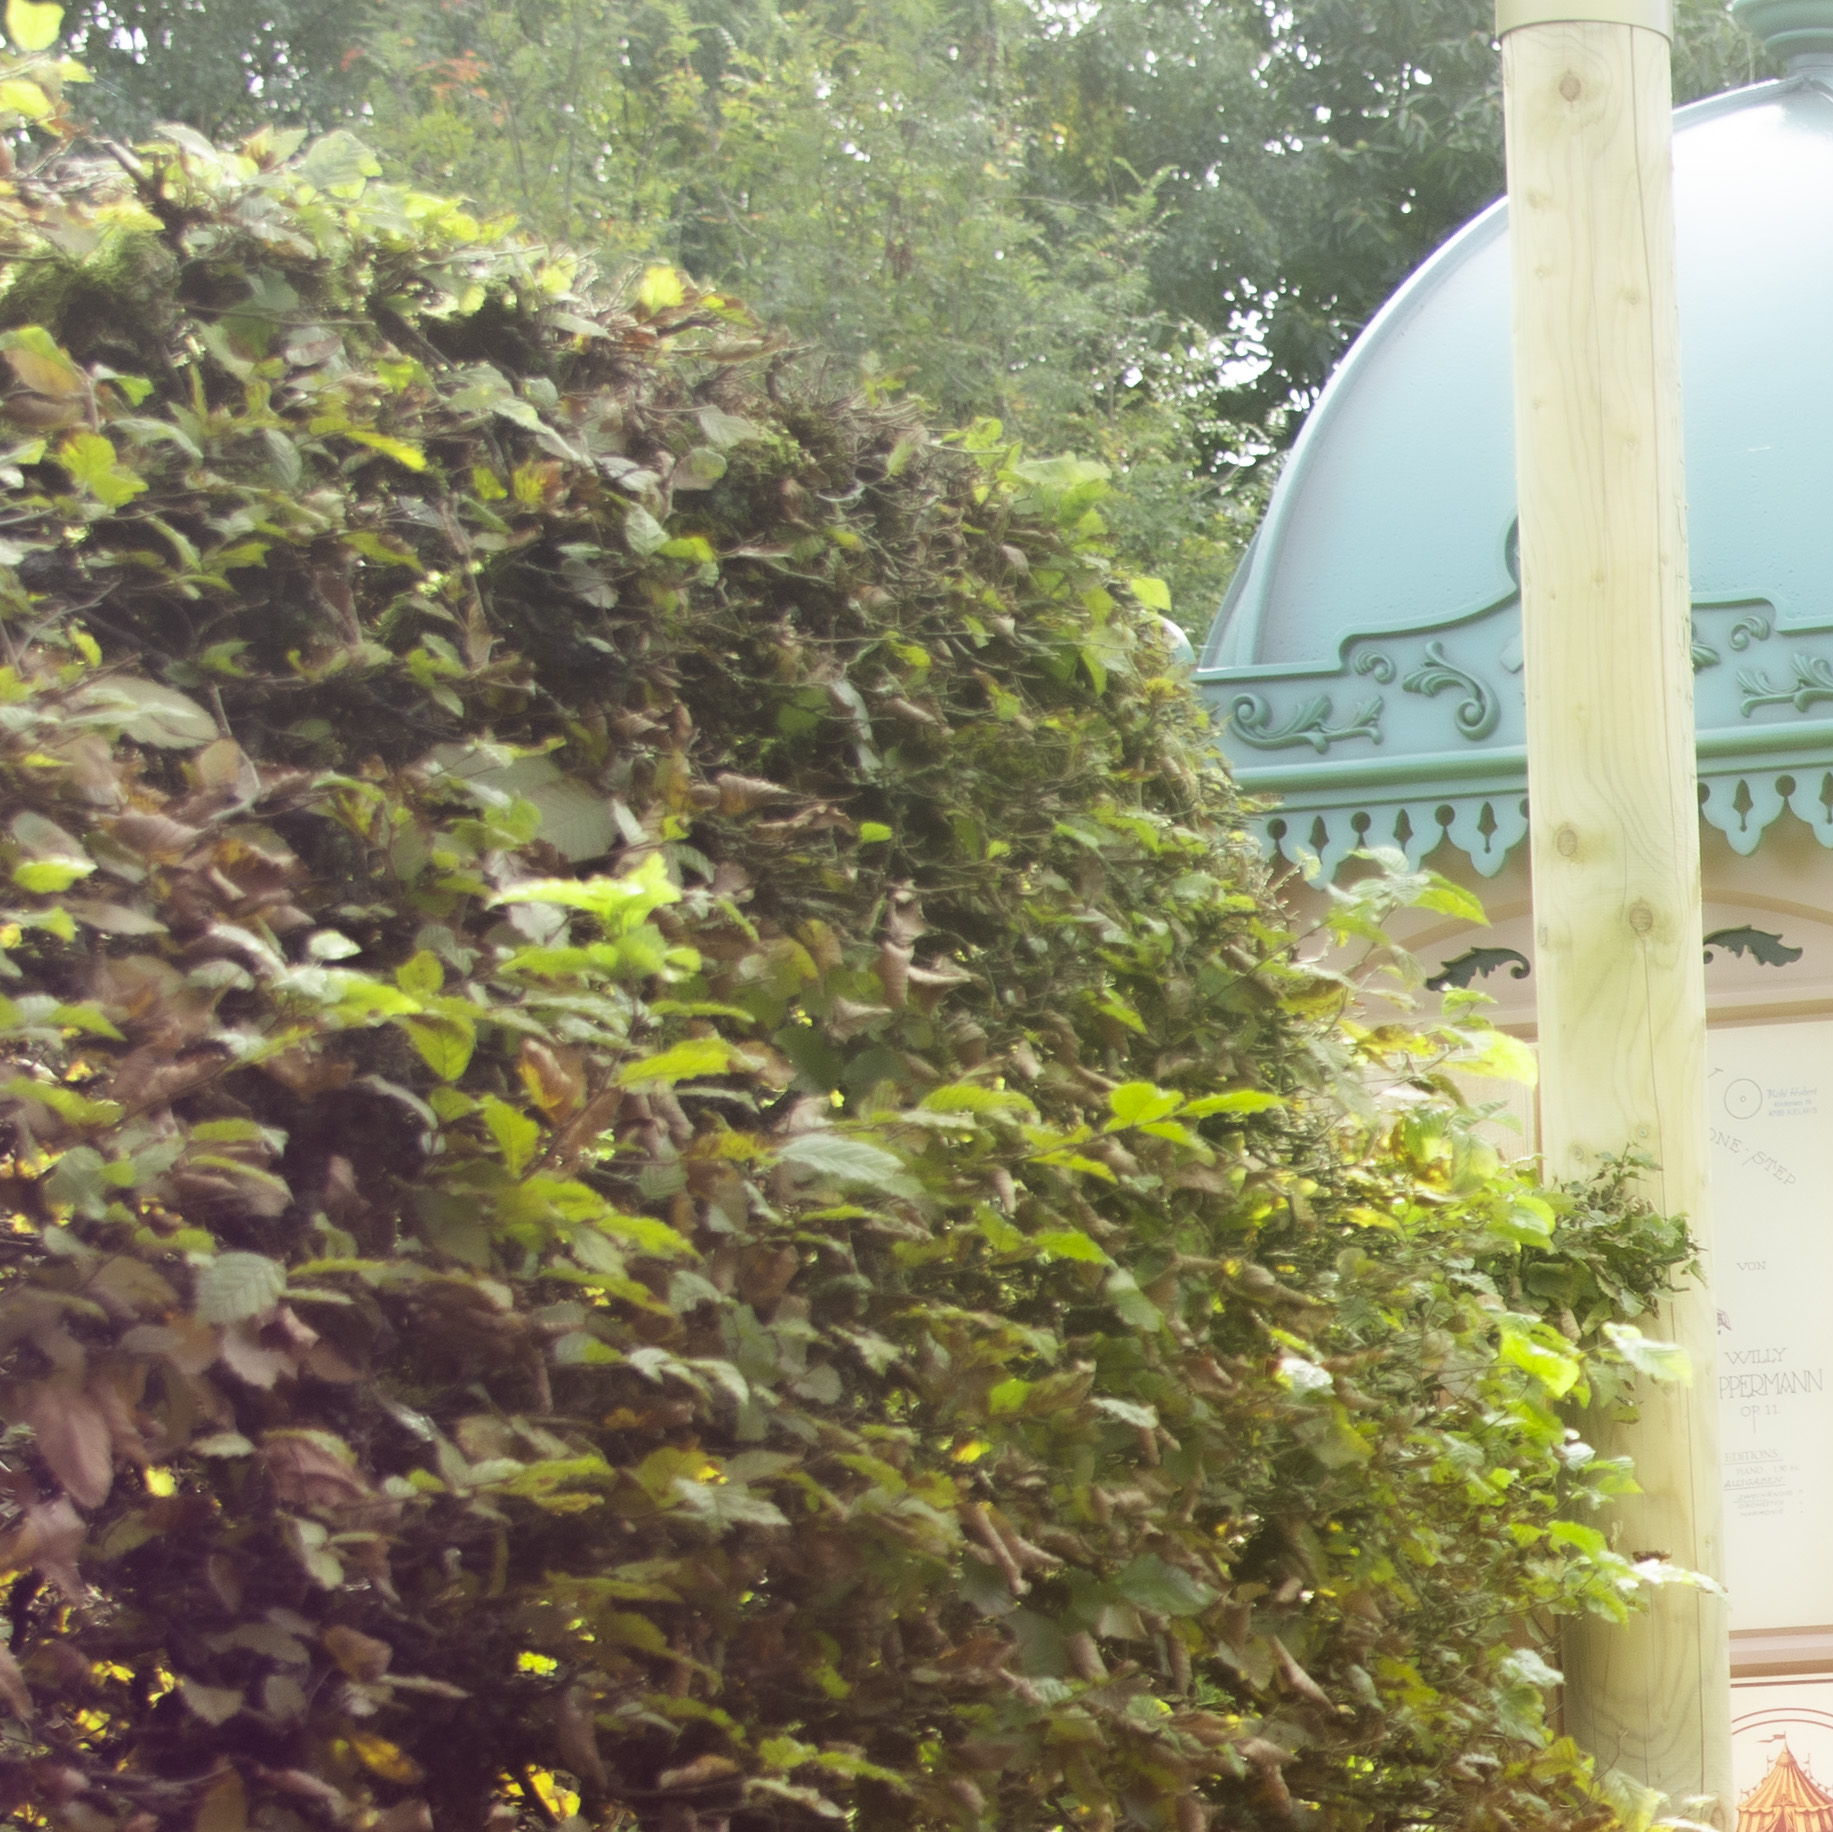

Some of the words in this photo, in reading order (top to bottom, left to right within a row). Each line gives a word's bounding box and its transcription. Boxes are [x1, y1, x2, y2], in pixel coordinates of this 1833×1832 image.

[1736, 1260, 1767, 1271] VON
[1724, 1347, 1788, 1365] WILLY
[1724, 1449, 1779, 1462] EDITIONS
